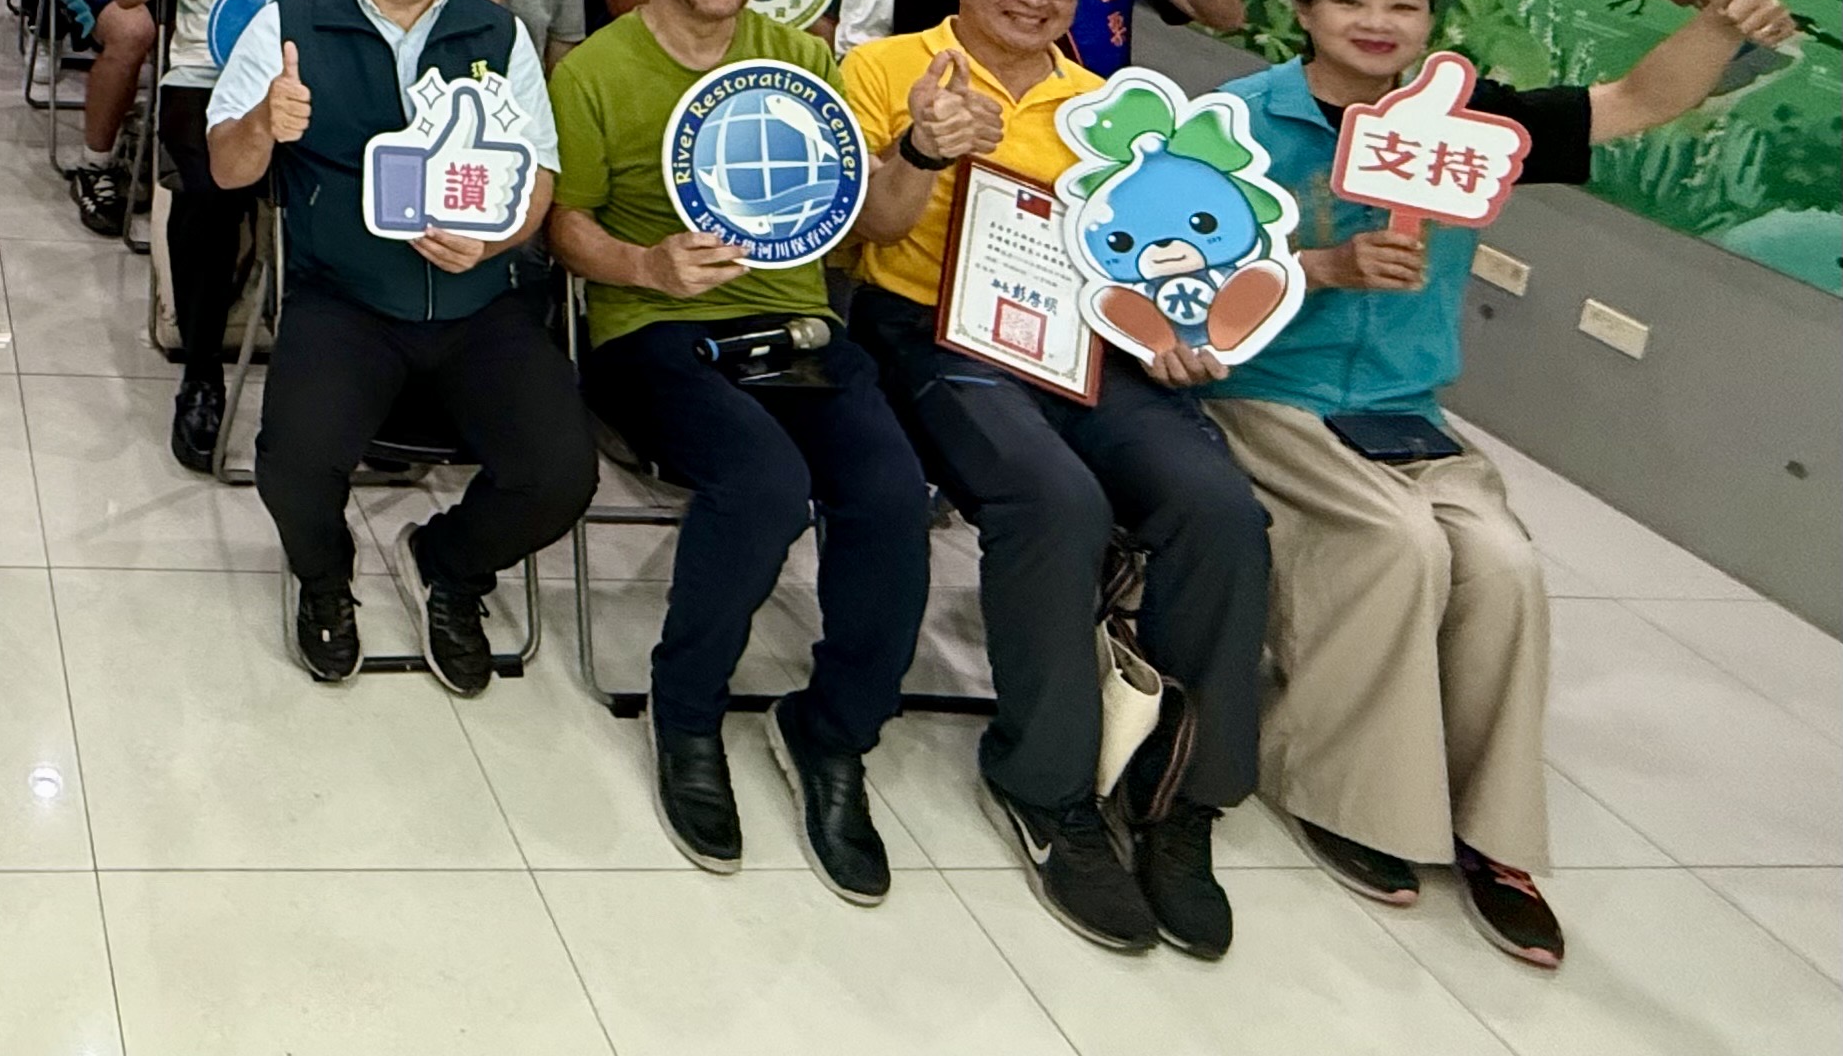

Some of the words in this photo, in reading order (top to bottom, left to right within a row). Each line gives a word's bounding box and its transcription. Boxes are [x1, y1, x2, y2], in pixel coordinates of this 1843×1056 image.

[673, 123, 696, 186] River
[689, 73, 818, 119] Restoration
[822, 102, 856, 182] Center
[444, 161, 490, 213] 讚
[1358, 131, 1489, 194] 支持
[1164, 283, 1210, 320] 水
